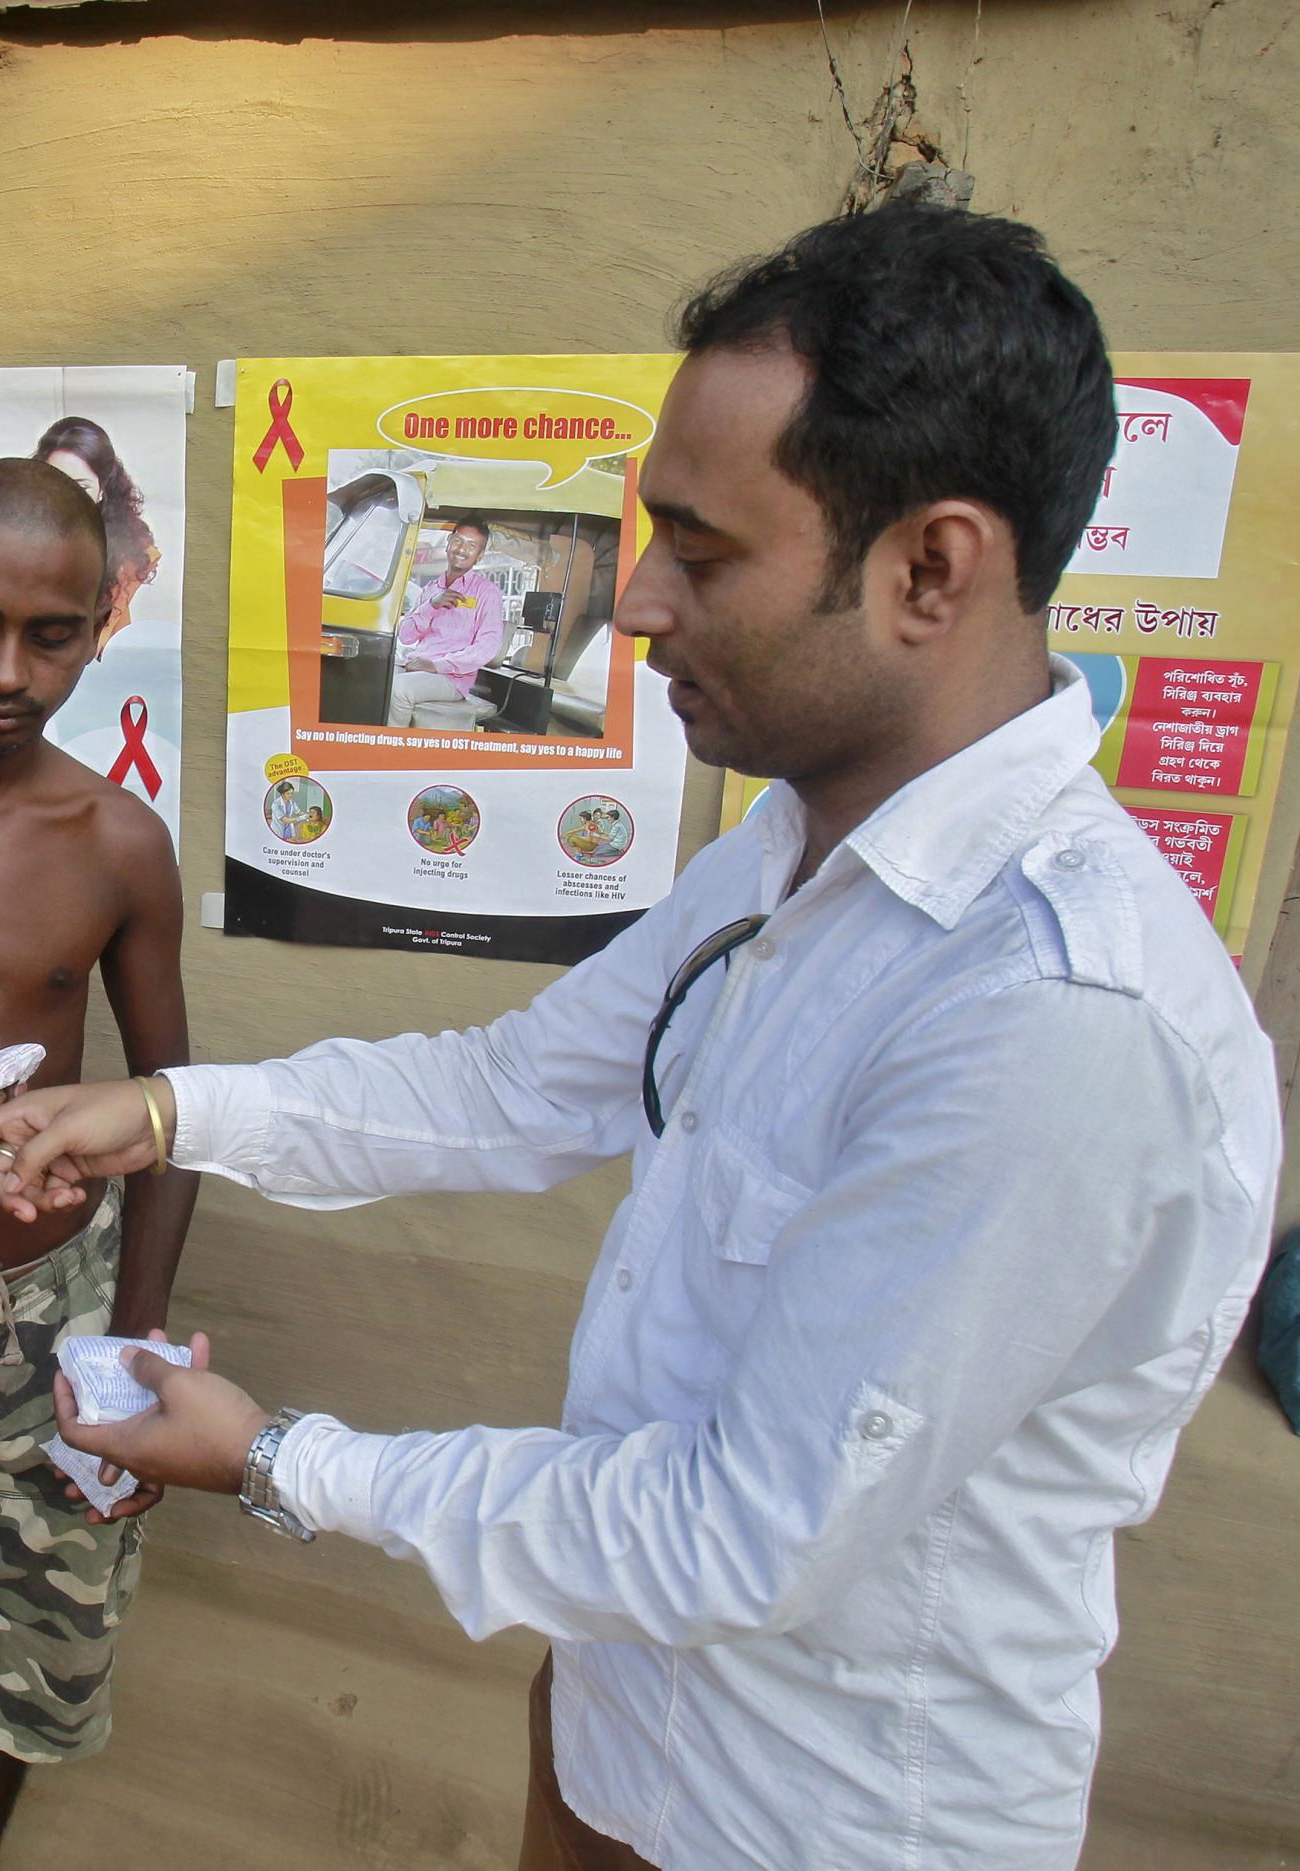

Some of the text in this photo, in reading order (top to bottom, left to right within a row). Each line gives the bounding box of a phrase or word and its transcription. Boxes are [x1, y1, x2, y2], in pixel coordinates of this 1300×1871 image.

[404, 412, 632, 440] One more chance...
[1134, 599, 1219, 637] উপায়
[1164, 669, 1226, 684] পরিশোধিত
[1163, 686, 1243, 703] সিরিঞ্জ ব্যবহার
[1152, 721, 1213, 735] নেশাজাতীয়
[296, 729, 622, 760] Say no to injecting drugs, say yes to OST treatment, say yes to a happy life
[1160, 736, 1225, 753] সিরিঞ্জ দিয়ে
[284, 758, 299, 767] OST
[1159, 756, 1222, 770] গ্রহণ থেকে
[268, 766, 302, 778] advantage
[1151, 769, 1182, 783] বিরত
[1163, 819, 1223, 835] সংক্রমিত
[1165, 834, 1213, 852] গর্ভবতী
[262, 847, 278, 856] Care
[280, 848, 301, 857] under
[268, 857, 324, 869] supervision and
[421, 858, 462, 870] No urge for
[282, 868, 310, 877] counsel
[413, 867, 468, 880] injecting drugs
[557, 870, 627, 883] Lesser chances of
[562, 880, 619, 891] abscesses and
[555, 887, 626, 900] infections like HIV
[382, 927, 405, 935] Tripura
[405, 927, 423, 936] State
[441, 931, 465, 939] Control
[466, 933, 492, 943] Society
[440, 939, 463, 947] Tripura
